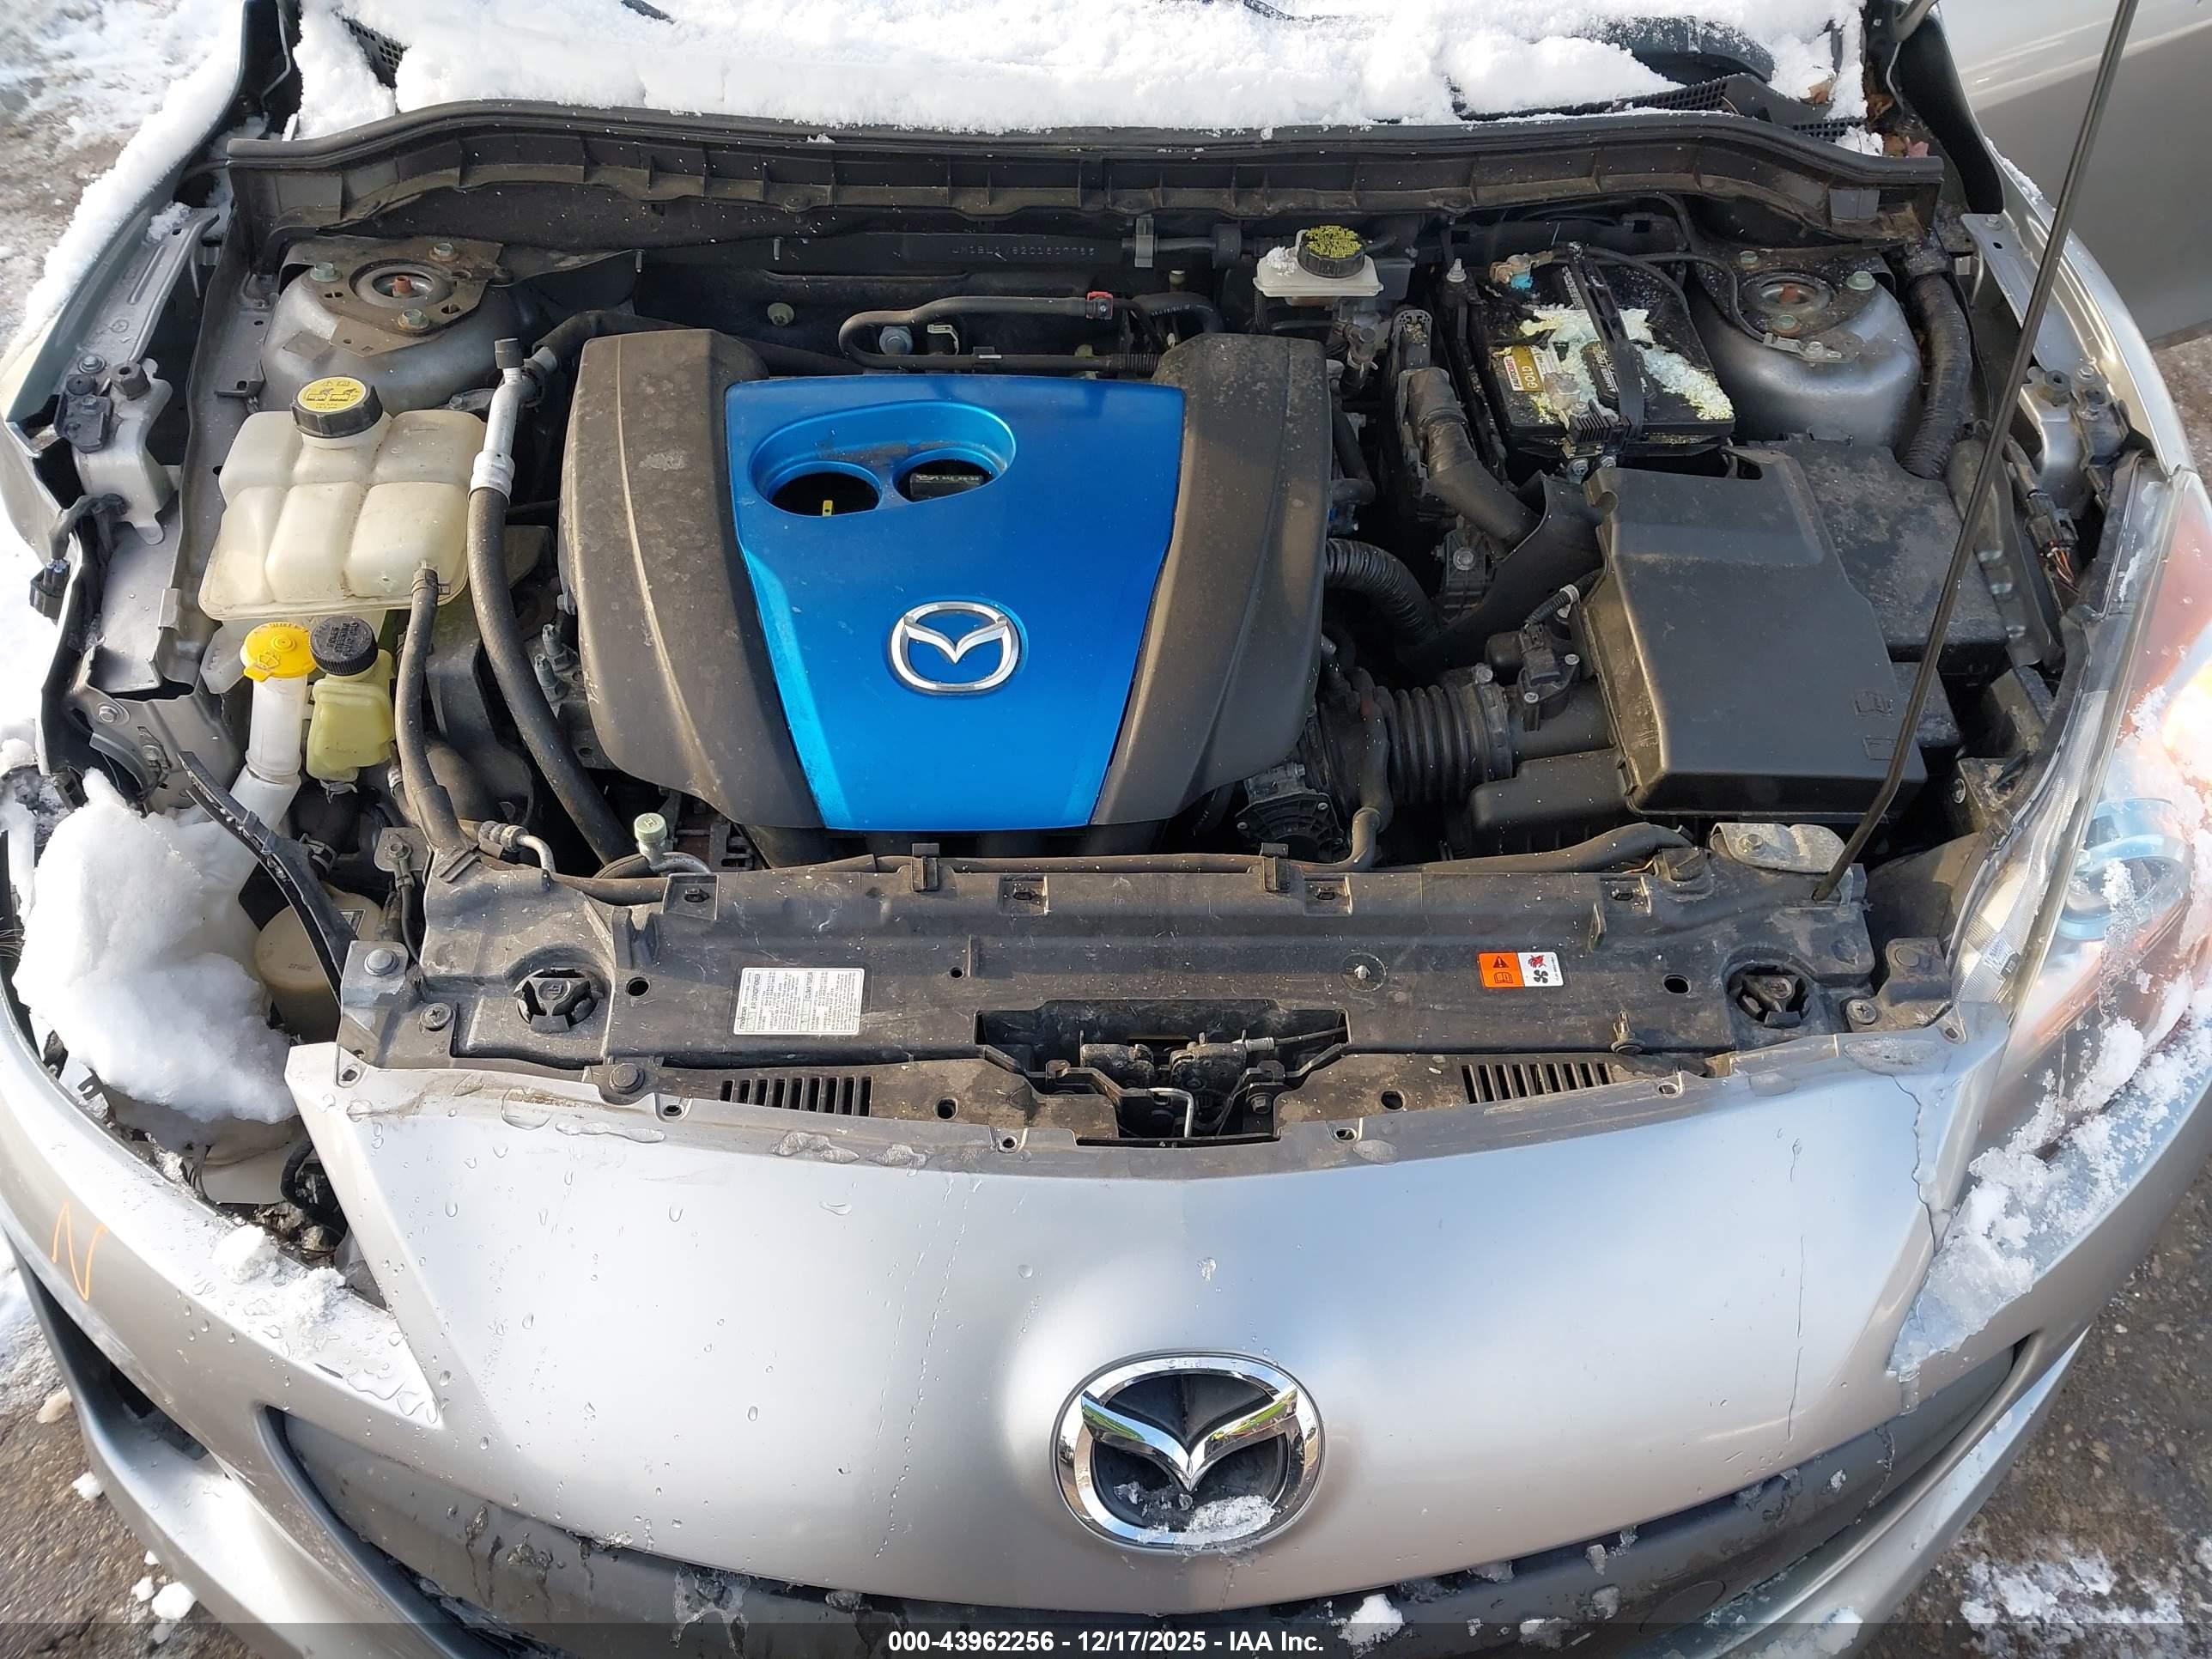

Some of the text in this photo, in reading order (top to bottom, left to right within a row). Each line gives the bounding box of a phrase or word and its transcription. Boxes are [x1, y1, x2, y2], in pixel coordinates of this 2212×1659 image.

[1521, 365, 1538, 389] GOLD
[1601, 368, 1614, 388] DANGER
[751, 973, 761, 1000] CONDITIONER
